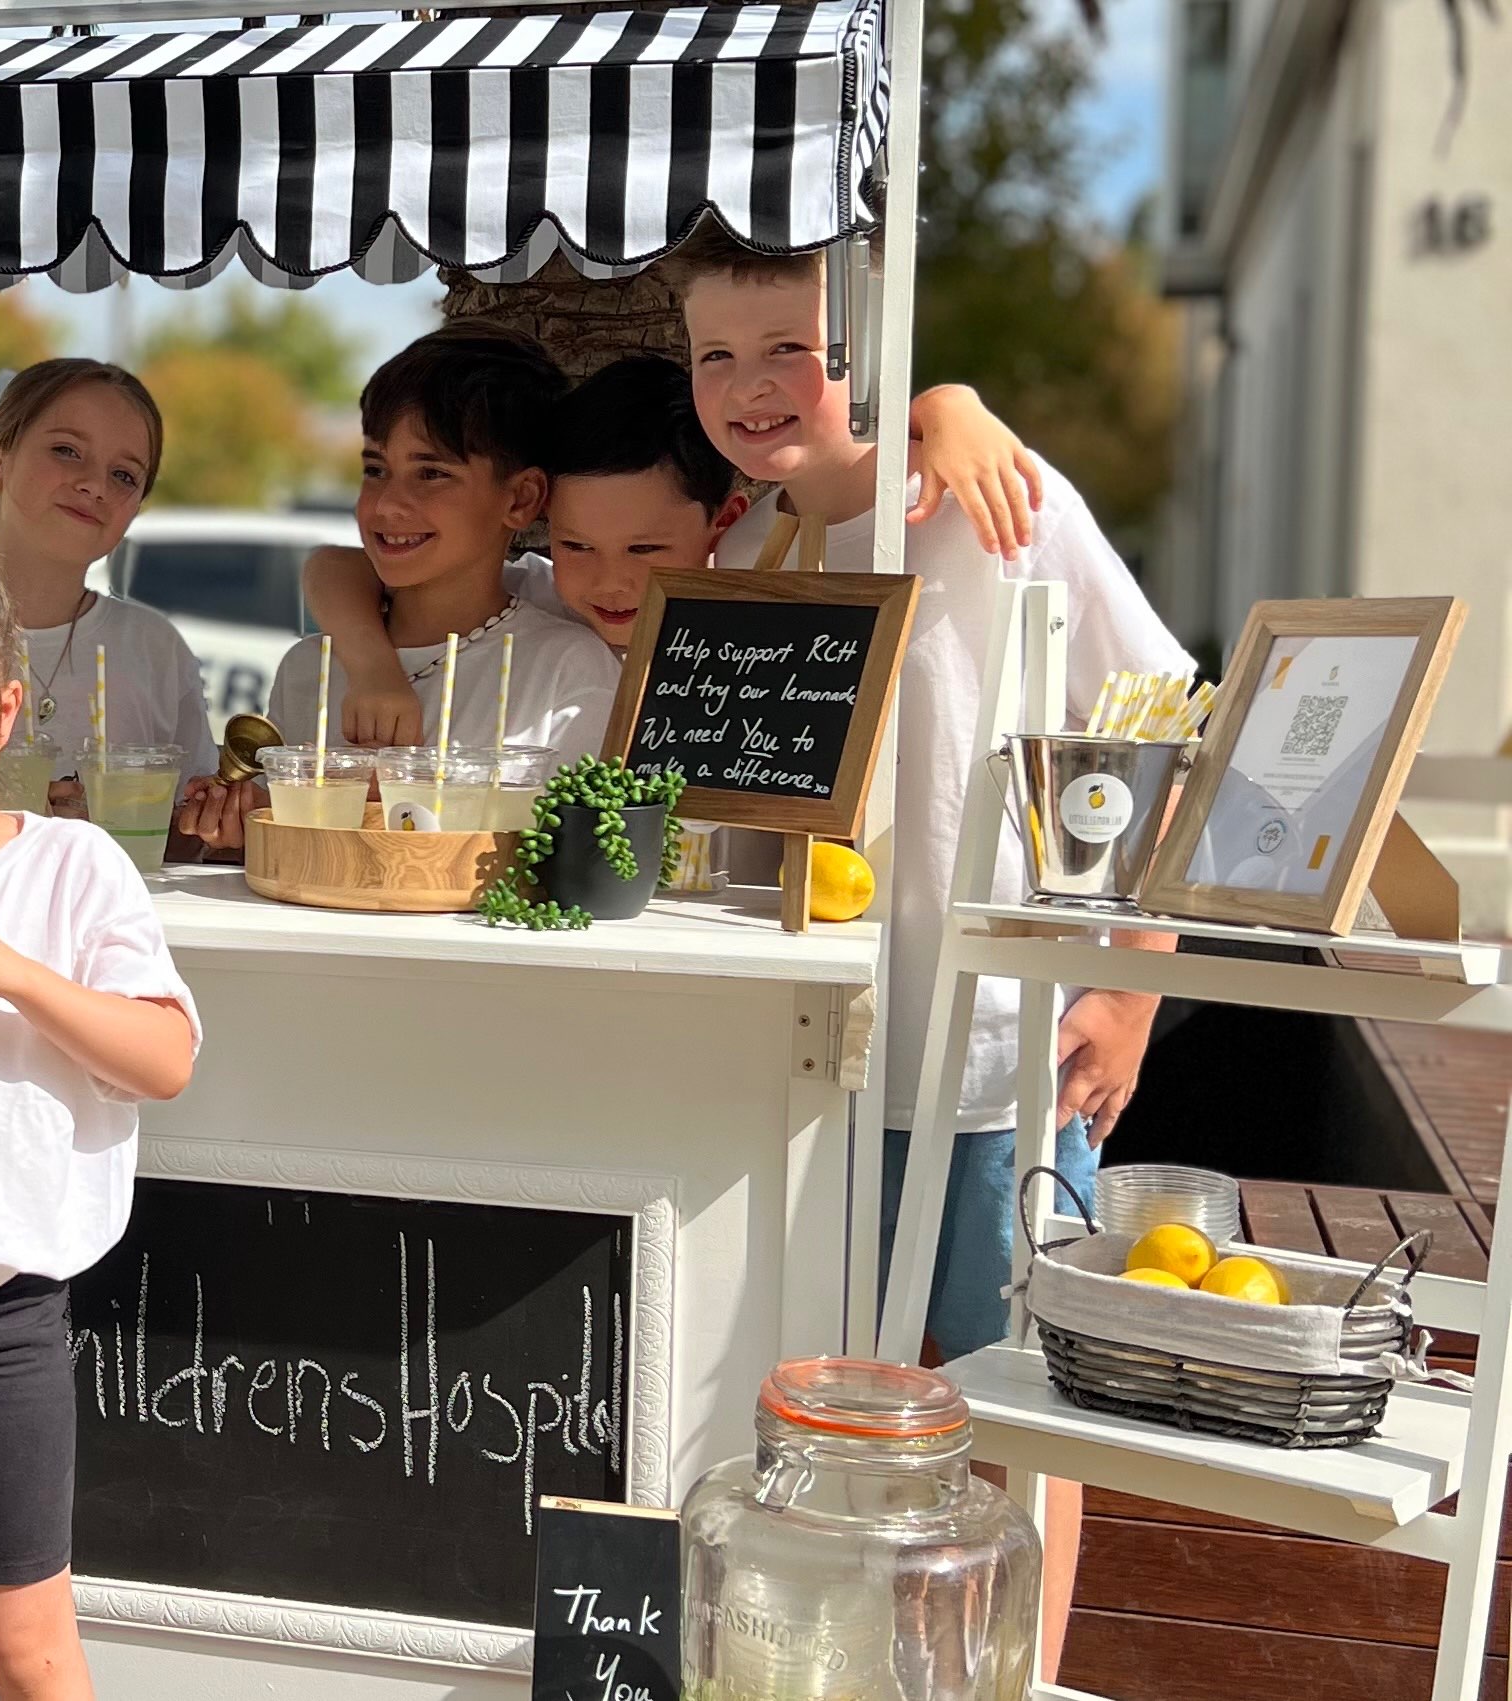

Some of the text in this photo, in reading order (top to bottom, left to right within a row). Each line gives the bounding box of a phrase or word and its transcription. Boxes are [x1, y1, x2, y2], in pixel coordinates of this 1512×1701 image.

[666, 628, 710, 670] Help
[805, 634, 858, 663] RCH
[656, 673, 856, 716] and try our lemonade
[640, 717, 815, 752] We need You to
[636, 756, 686, 775] make
[697, 764, 712, 777] a
[723, 758, 813, 790] difference
[554, 1584, 662, 1635] Thank
[595, 1653, 654, 1701] You
